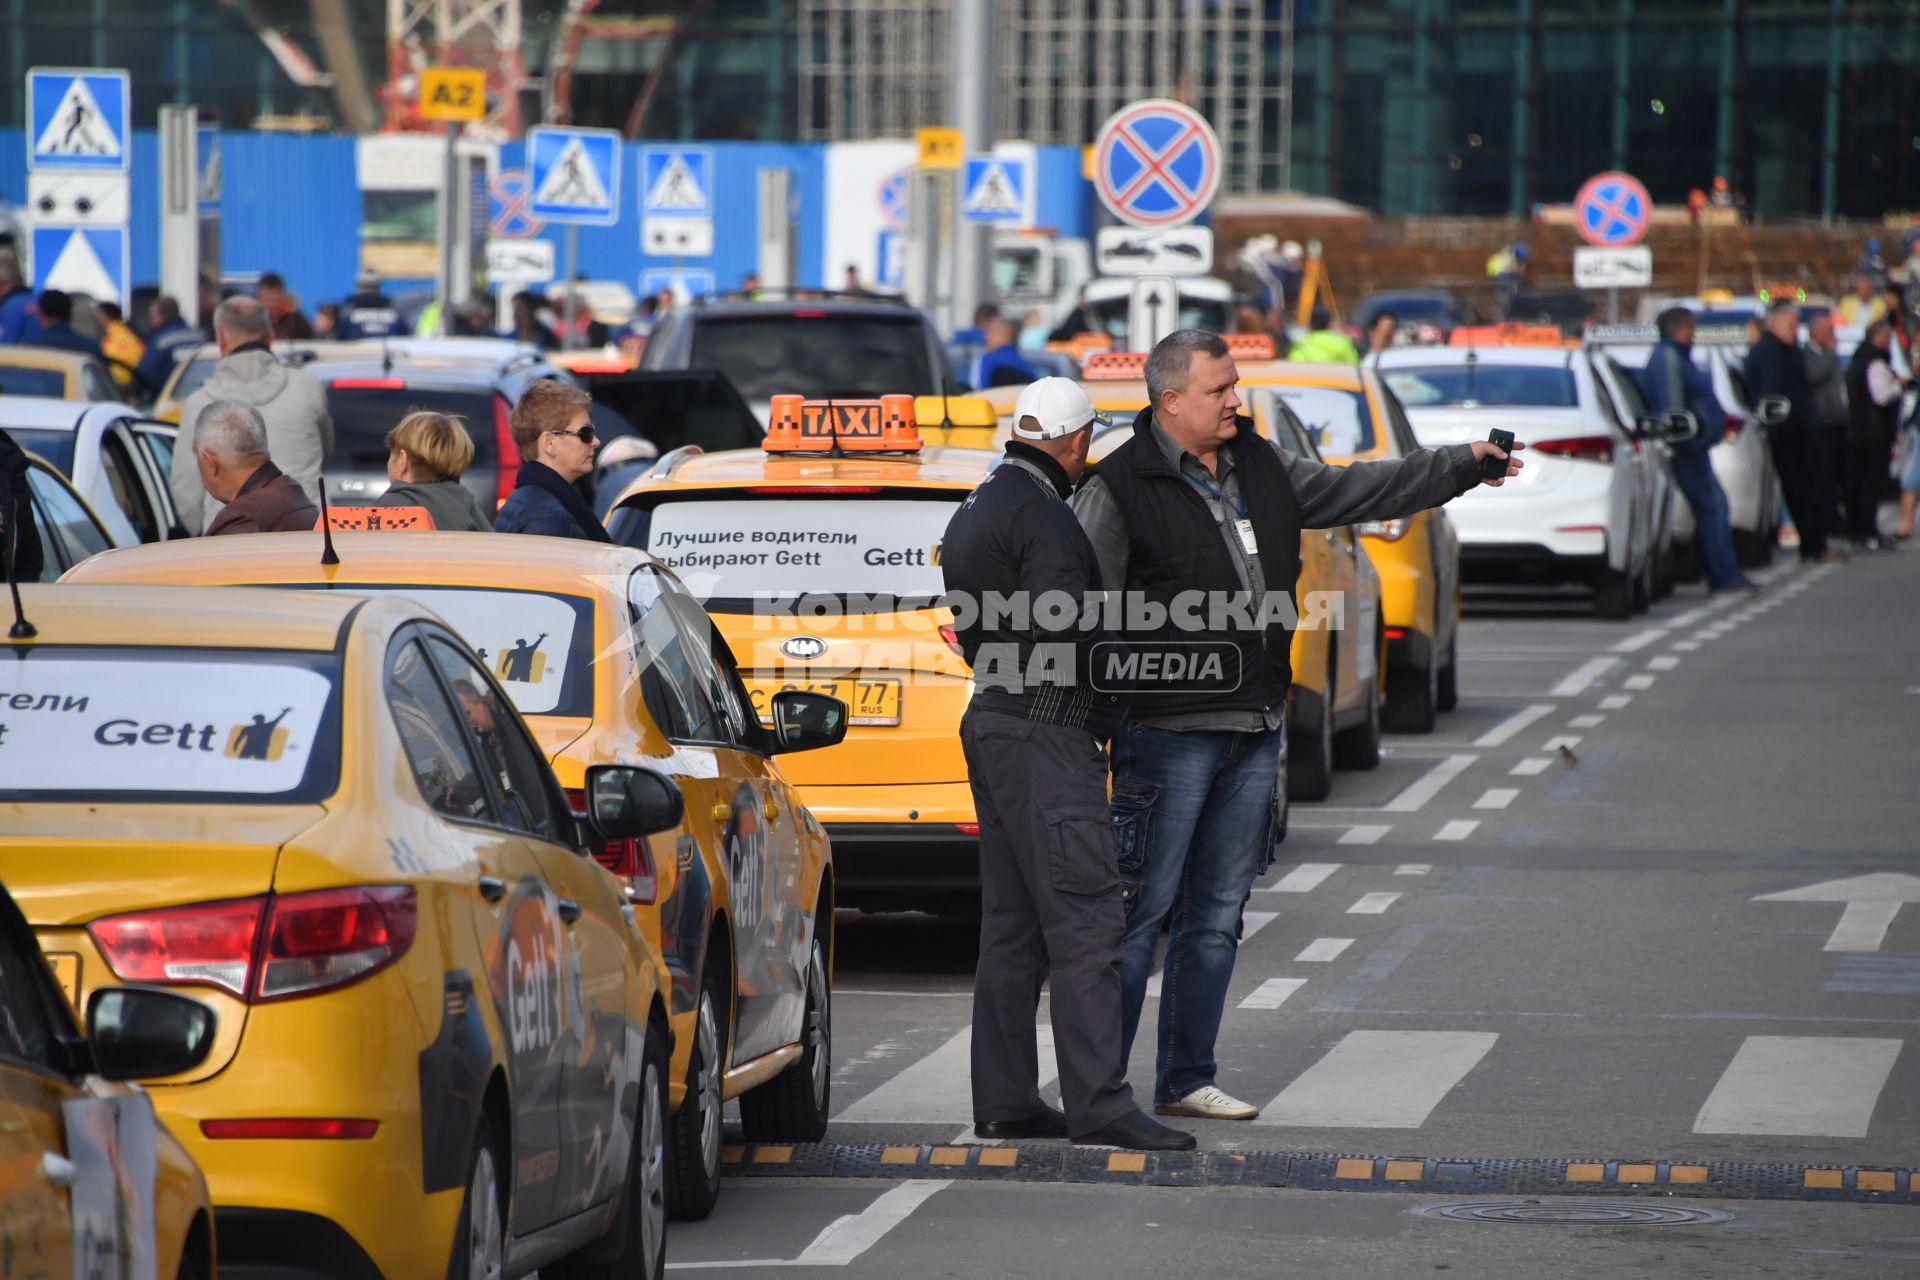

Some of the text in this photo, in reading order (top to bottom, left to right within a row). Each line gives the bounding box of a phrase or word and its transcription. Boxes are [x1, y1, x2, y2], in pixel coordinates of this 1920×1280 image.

[803, 407, 879, 435] TAXI
[656, 531, 858, 549] Лучшие водители
[775, 550, 821, 566] Gett
[863, 548, 925, 567] Gett
[858, 683, 888, 705] 77
[861, 705, 883, 714] RUS
[94, 719, 217, 751] Gett
